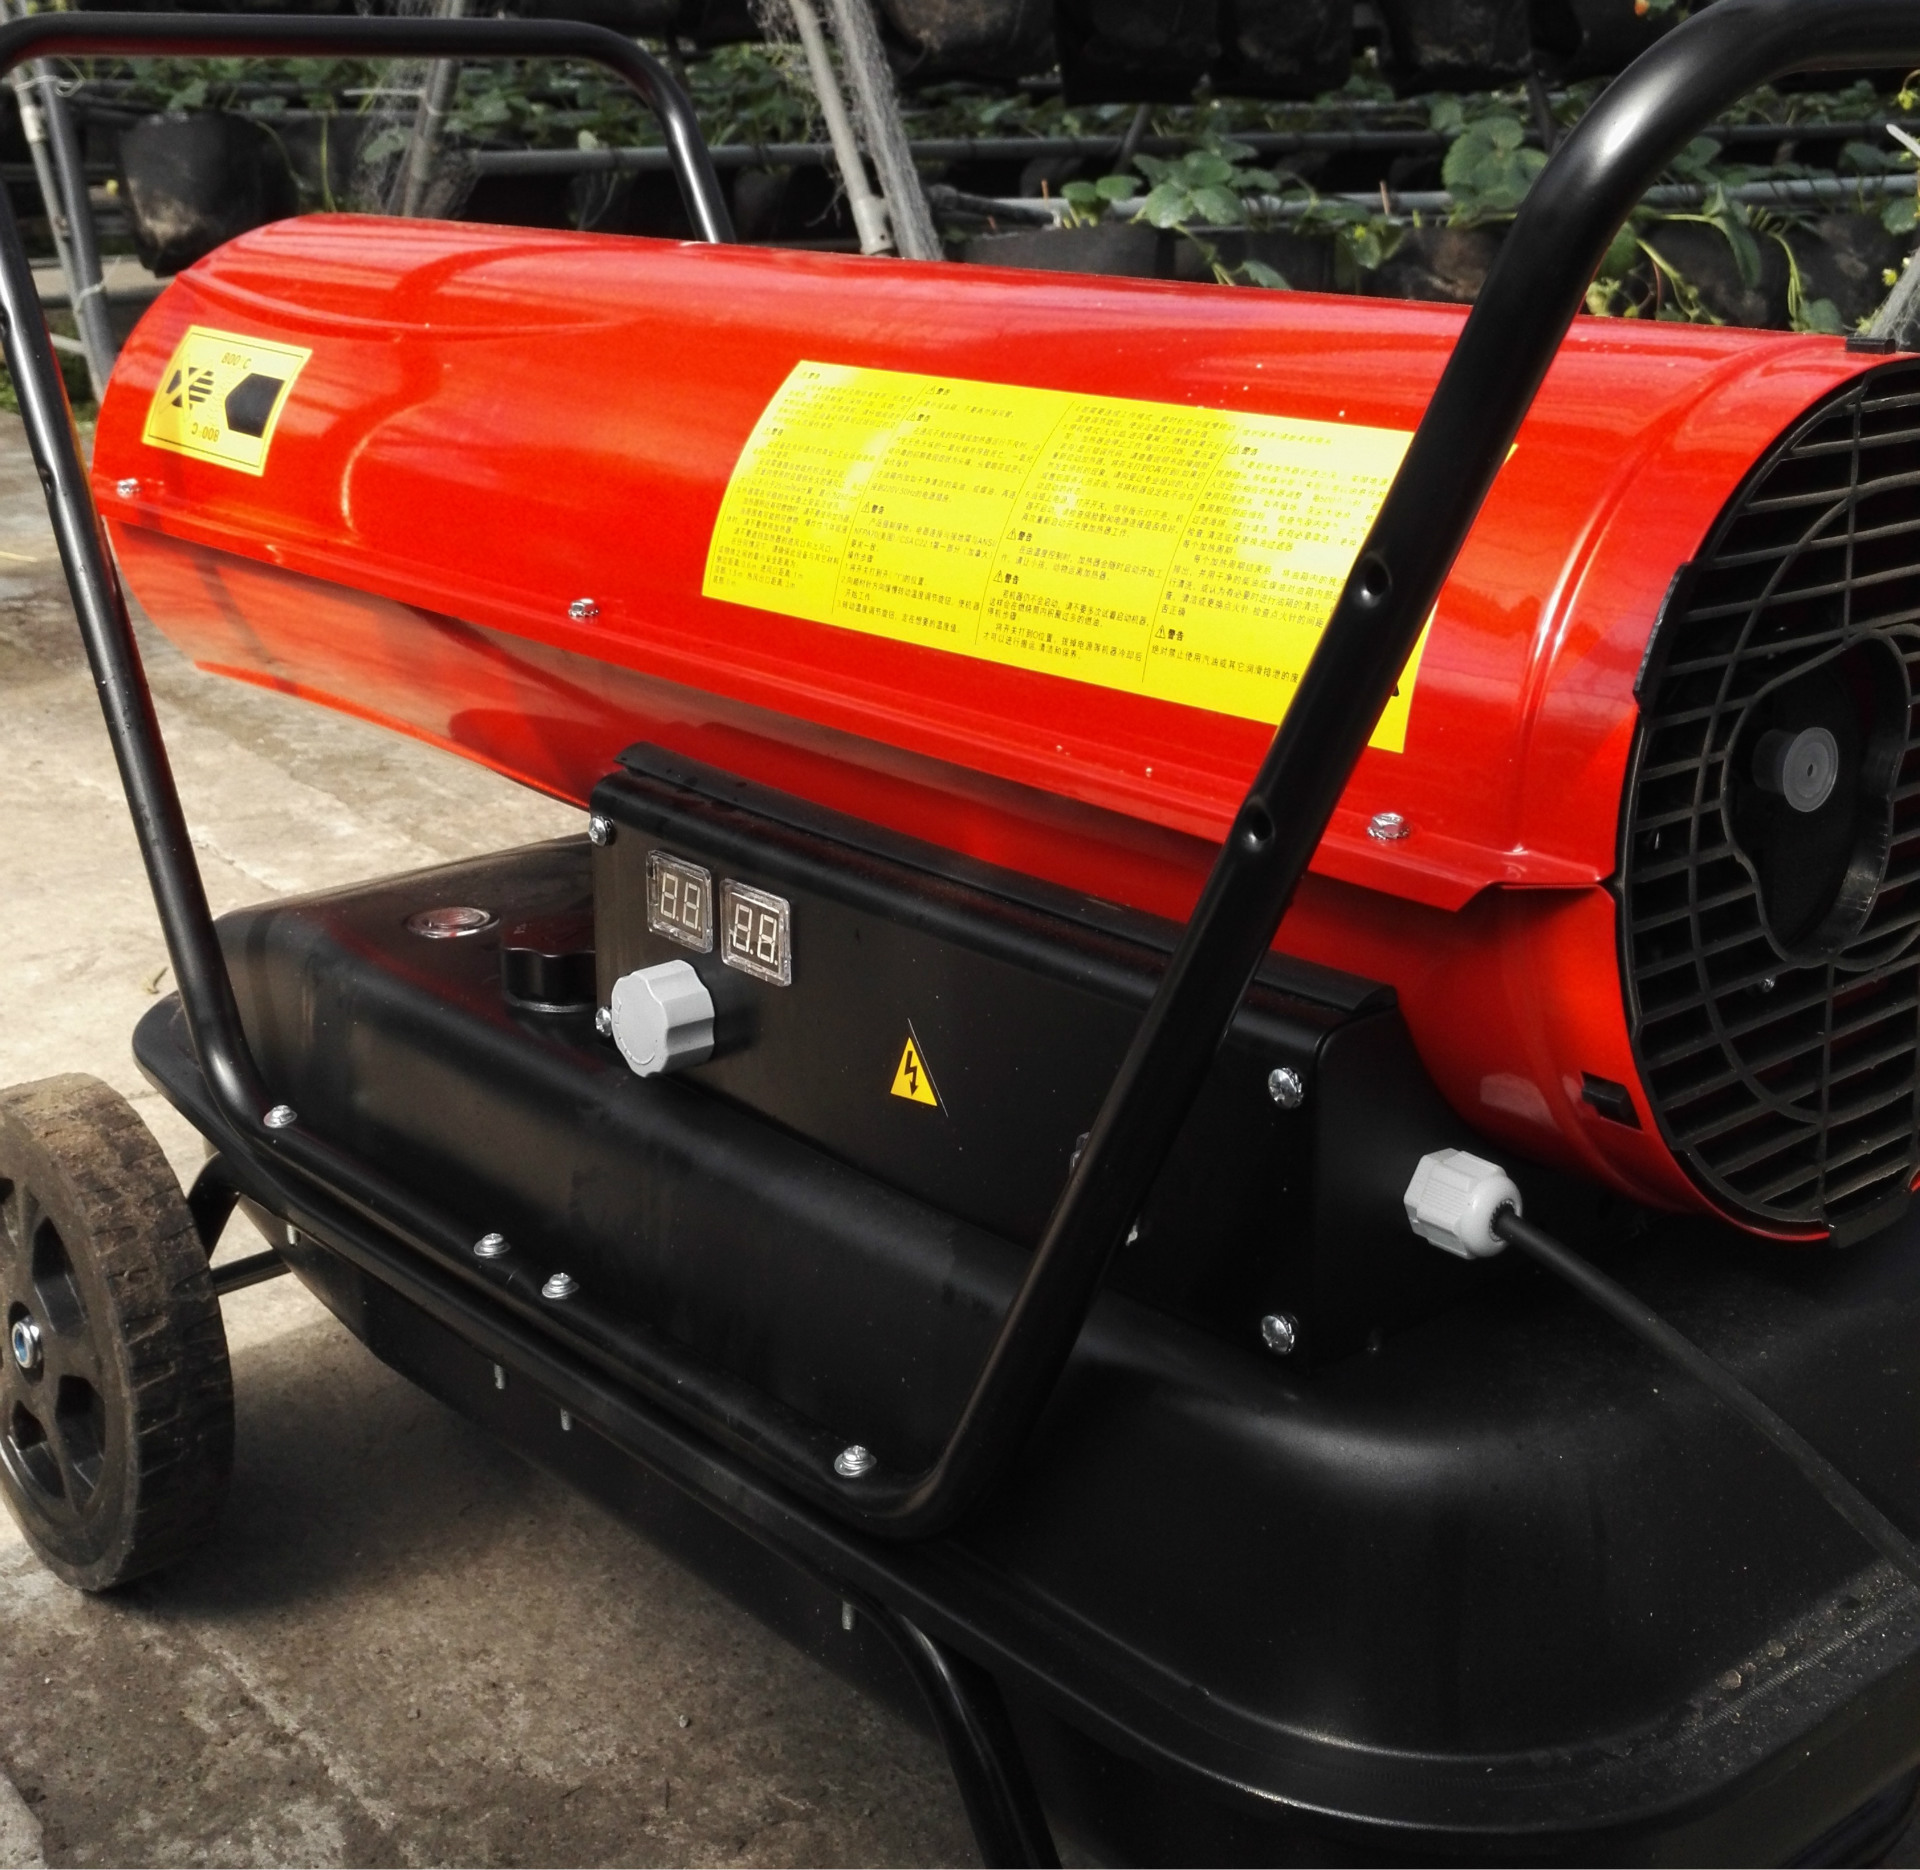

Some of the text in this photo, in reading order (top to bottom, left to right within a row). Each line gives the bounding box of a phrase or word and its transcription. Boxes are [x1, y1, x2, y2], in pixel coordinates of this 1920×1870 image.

[872, 504, 884, 515] 警告
[1017, 531, 1032, 542] 警告
[1005, 573, 1019, 585] 警告
[1168, 629, 1184, 641] 警告
